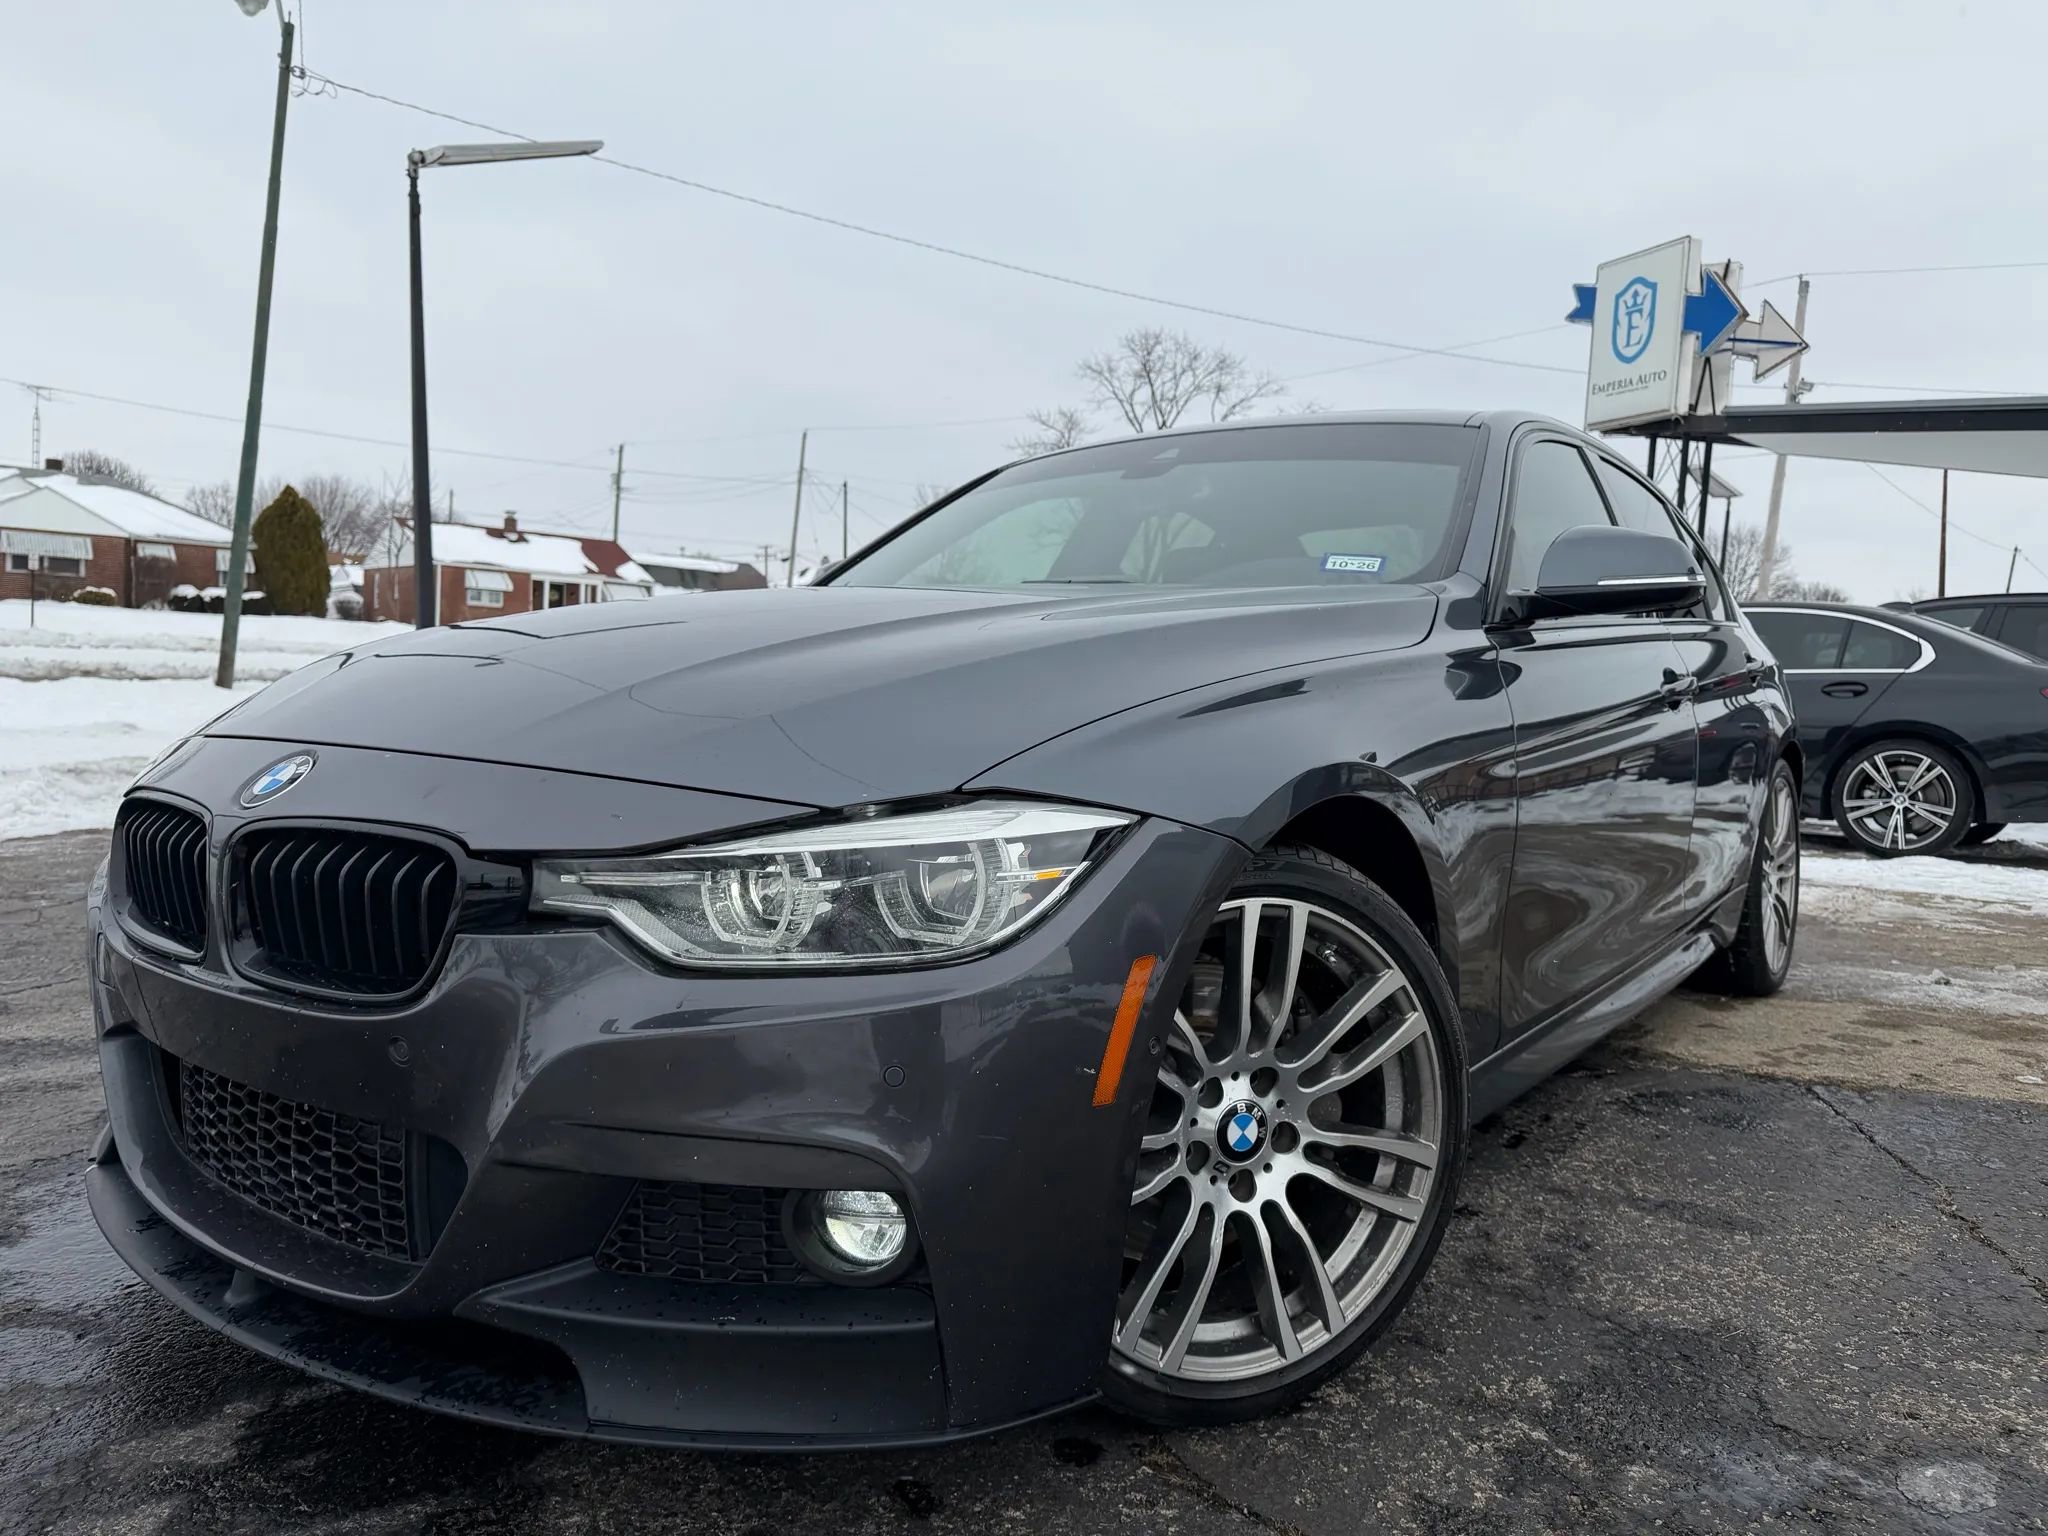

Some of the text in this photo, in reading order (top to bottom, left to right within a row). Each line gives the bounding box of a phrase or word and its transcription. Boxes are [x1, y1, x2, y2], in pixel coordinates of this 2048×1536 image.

[1622, 308, 1644, 348] E
[1592, 377, 1634, 395] EMPERIA
[1636, 369, 1667, 385] AUTO
[1237, 1102, 1266, 1138] BMW
